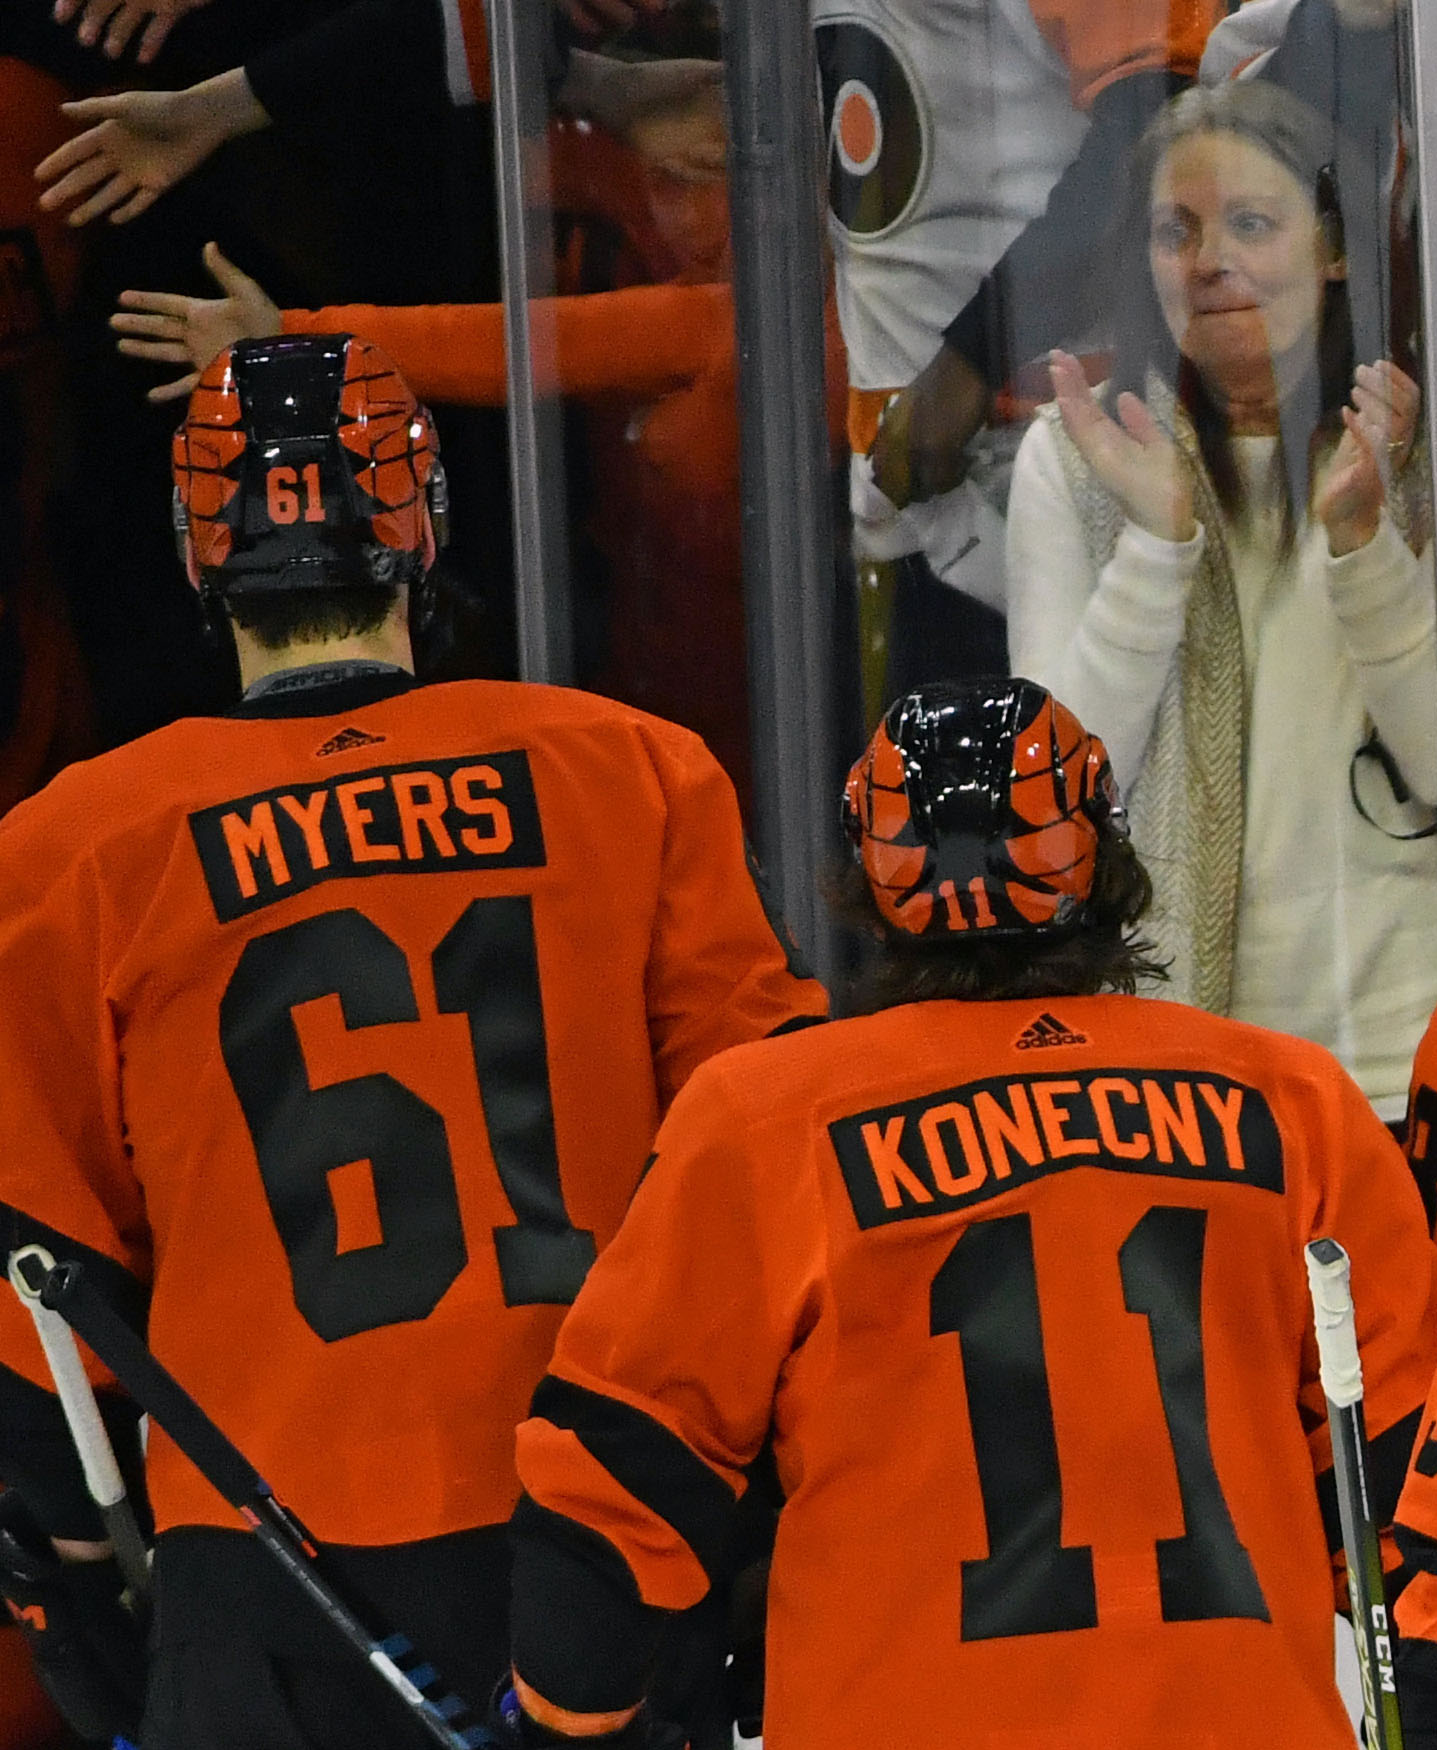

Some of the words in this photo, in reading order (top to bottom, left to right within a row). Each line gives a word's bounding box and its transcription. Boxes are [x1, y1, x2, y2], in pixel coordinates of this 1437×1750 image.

[266, 463, 326, 525] 61
[221, 764, 514, 900] MYERS
[938, 877, 998, 931] 11
[1015, 1030, 1087, 1050] adidas
[219, 895, 597, 1344] 61
[861, 1080, 1247, 1210] KONECNY
[930, 1205, 1272, 1642] 11
[1371, 1603, 1397, 1693] CCM
